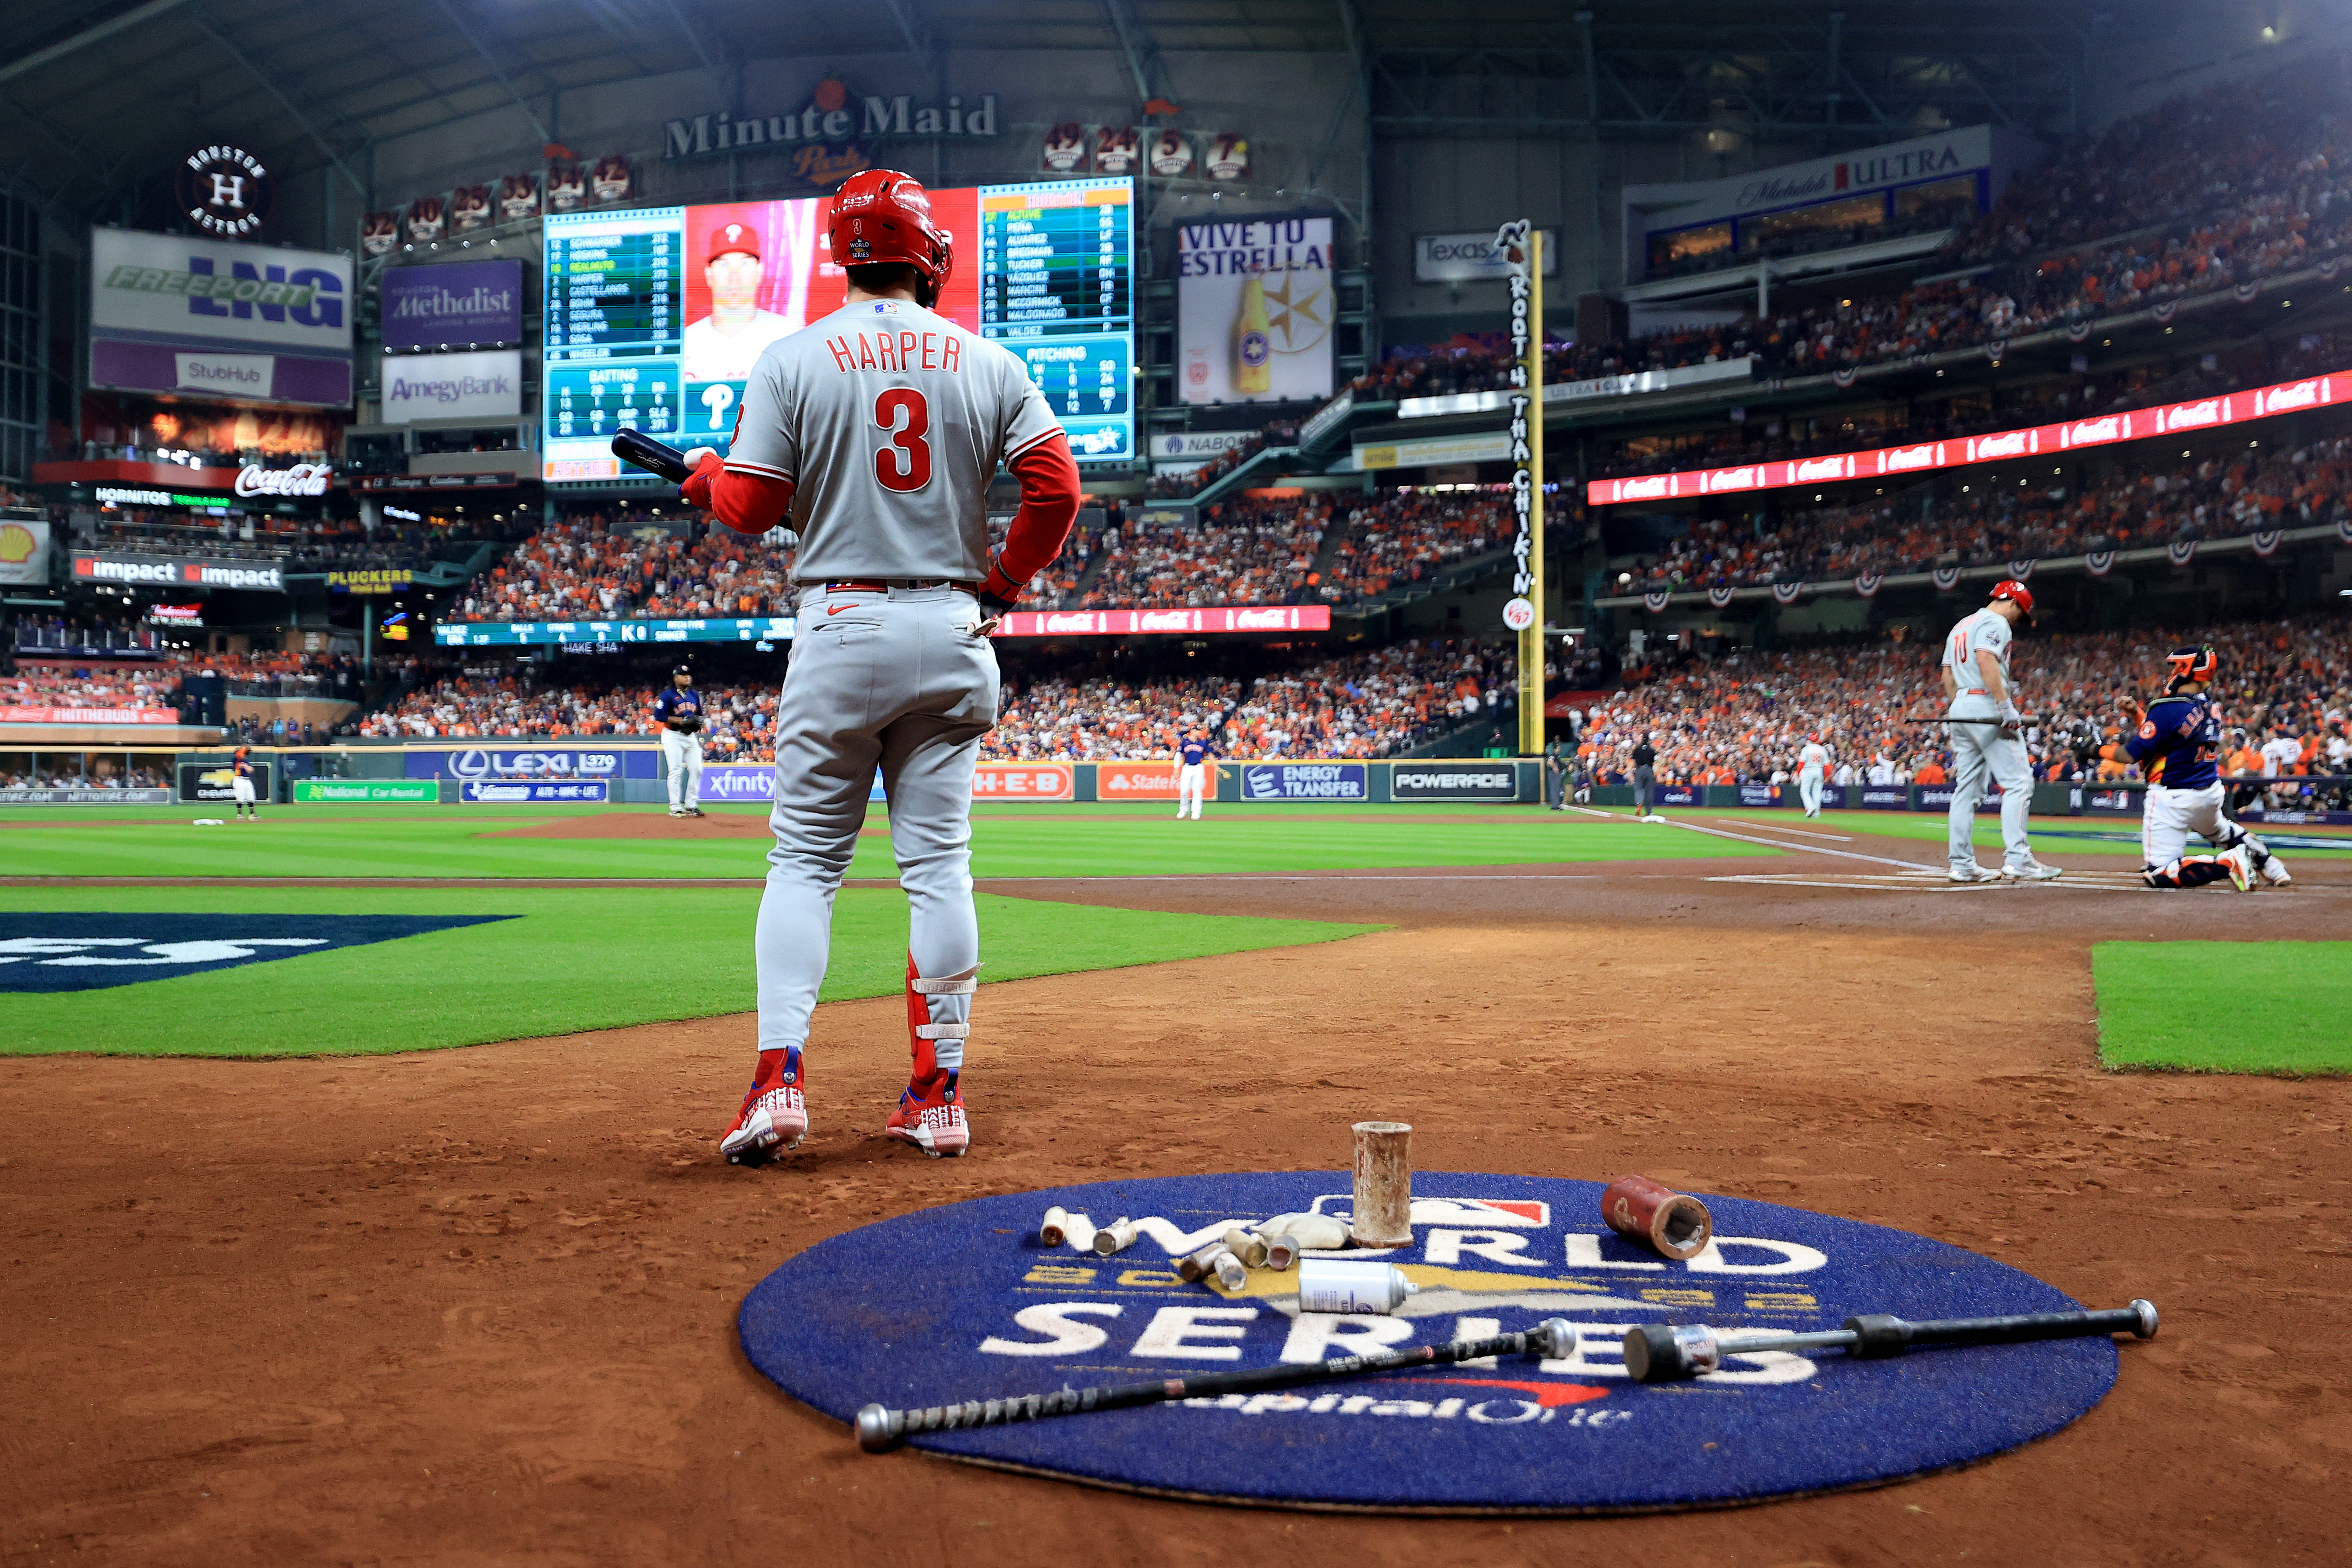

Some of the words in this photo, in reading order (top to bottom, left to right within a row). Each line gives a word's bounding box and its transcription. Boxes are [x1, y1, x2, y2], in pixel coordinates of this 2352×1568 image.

[664, 101, 849, 158] Minute
[863, 95, 997, 135] Maid
[187, 145, 266, 178] HOUSTON
[1855, 144, 1959, 184] ULTRA
[210, 172, 245, 209] H
[190, 207, 261, 235] ASTROS
[1007, 208, 1043, 221] ALTUVE
[853, 219, 862, 235] 3
[1267, 219, 1304, 244] TU
[570, 235, 623, 249] SCHWARBER
[1007, 233, 1048, 247] ALVAREZ
[570, 249, 608, 261] HOSKINS
[1007, 245, 1054, 259] BREGMAN
[1423, 238, 1489, 261] Texas
[1007, 259, 1045, 272] TUCKER
[112, 266, 312, 306] FREEPORT
[570, 273, 605, 286] HARPER
[189, 256, 342, 328] LNG
[570, 283, 630, 297] CASTELLANOS
[393, 287, 511, 317] Methodist
[1007, 308, 1067, 321] MALDONADO
[1007, 325, 1044, 337] VALDEZ
[569, 348, 611, 359] WHEELER
[824, 330, 960, 374] HARPER
[1027, 346, 1087, 363] PITCHING
[188, 362, 260, 382] StubHub
[589, 368, 639, 384] BATTING
[1510, 366, 1528, 389] 4
[391, 375, 509, 402] AmegyBank
[1510, 395, 1530, 463] THA
[873, 386, 933, 494] 3
[553, 461, 611, 476] ASTROS
[96, 487, 172, 506] HORNITOS
[173, 494, 208, 506] TEQUILA
[209, 497, 231, 507] BAR
[1512, 469, 1531, 595] CHIKIN
[93, 561, 176, 582] impact
[200, 565, 280, 588] impact
[329, 570, 412, 585] PLUCKERS
[621, 624, 636, 642] K
[655, 630, 688, 641] SINKER
[1954, 630, 1968, 666] 10
[53, 708, 138, 724] #HITTHEBUDS
[587, 755, 615, 767] 370
[1283, 766, 1342, 781] ENERGY
[1396, 773, 1510, 789] POWERADE
[322, 786, 367, 798] National
[373, 788, 389, 798] Car
[389, 788, 424, 799] Rental
[535, 786, 555, 798] AUTO
[558, 786, 579, 798] HOME
[583, 786, 599, 798] LIFE
[710, 770, 775, 798] xfinity
[1283, 781, 1361, 797] TRANSFER
